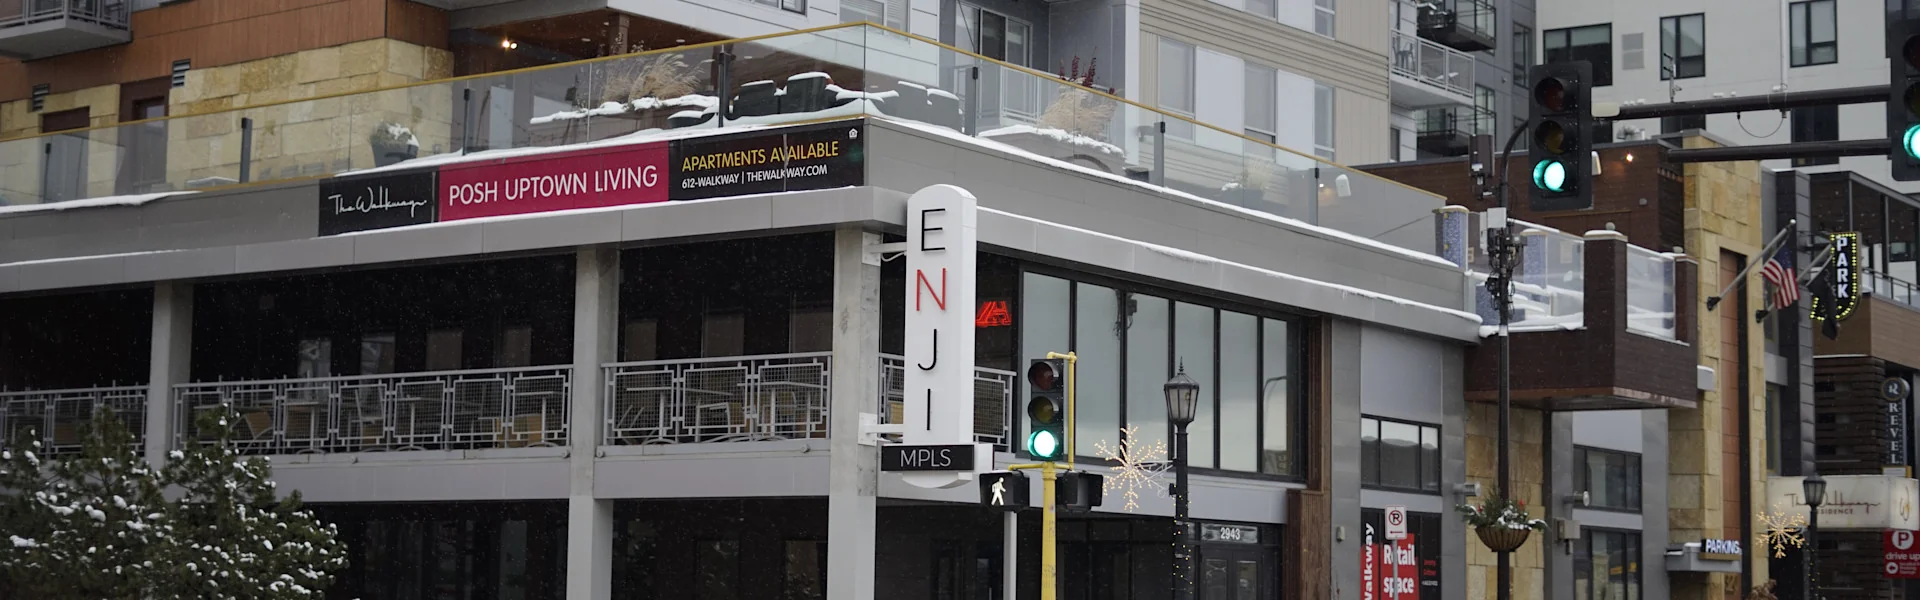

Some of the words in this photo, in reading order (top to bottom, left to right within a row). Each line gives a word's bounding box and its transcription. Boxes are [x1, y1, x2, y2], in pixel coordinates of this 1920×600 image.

[682, 149, 765, 172] APARTMENTS
[770, 141, 839, 163] AVAILABLE
[449, 182, 498, 206] POSH
[505, 173, 588, 200] UPTOWN
[595, 165, 658, 192] LIVING
[682, 172, 739, 189] 612-WALKWAY
[747, 164, 828, 182] THEWALKWAY.COM
[328, 194, 355, 215] The
[356, 186, 427, 218] Walkway
[1837, 237, 1849, 299] PARK
[916, 208, 946, 431] ENJI
[1889, 402, 1899, 464] REVEL
[900, 449, 951, 469] MPLS
[1220, 527, 1241, 540] 2943
[1898, 532, 1909, 546] P
[1885, 552, 1908, 560] drive
